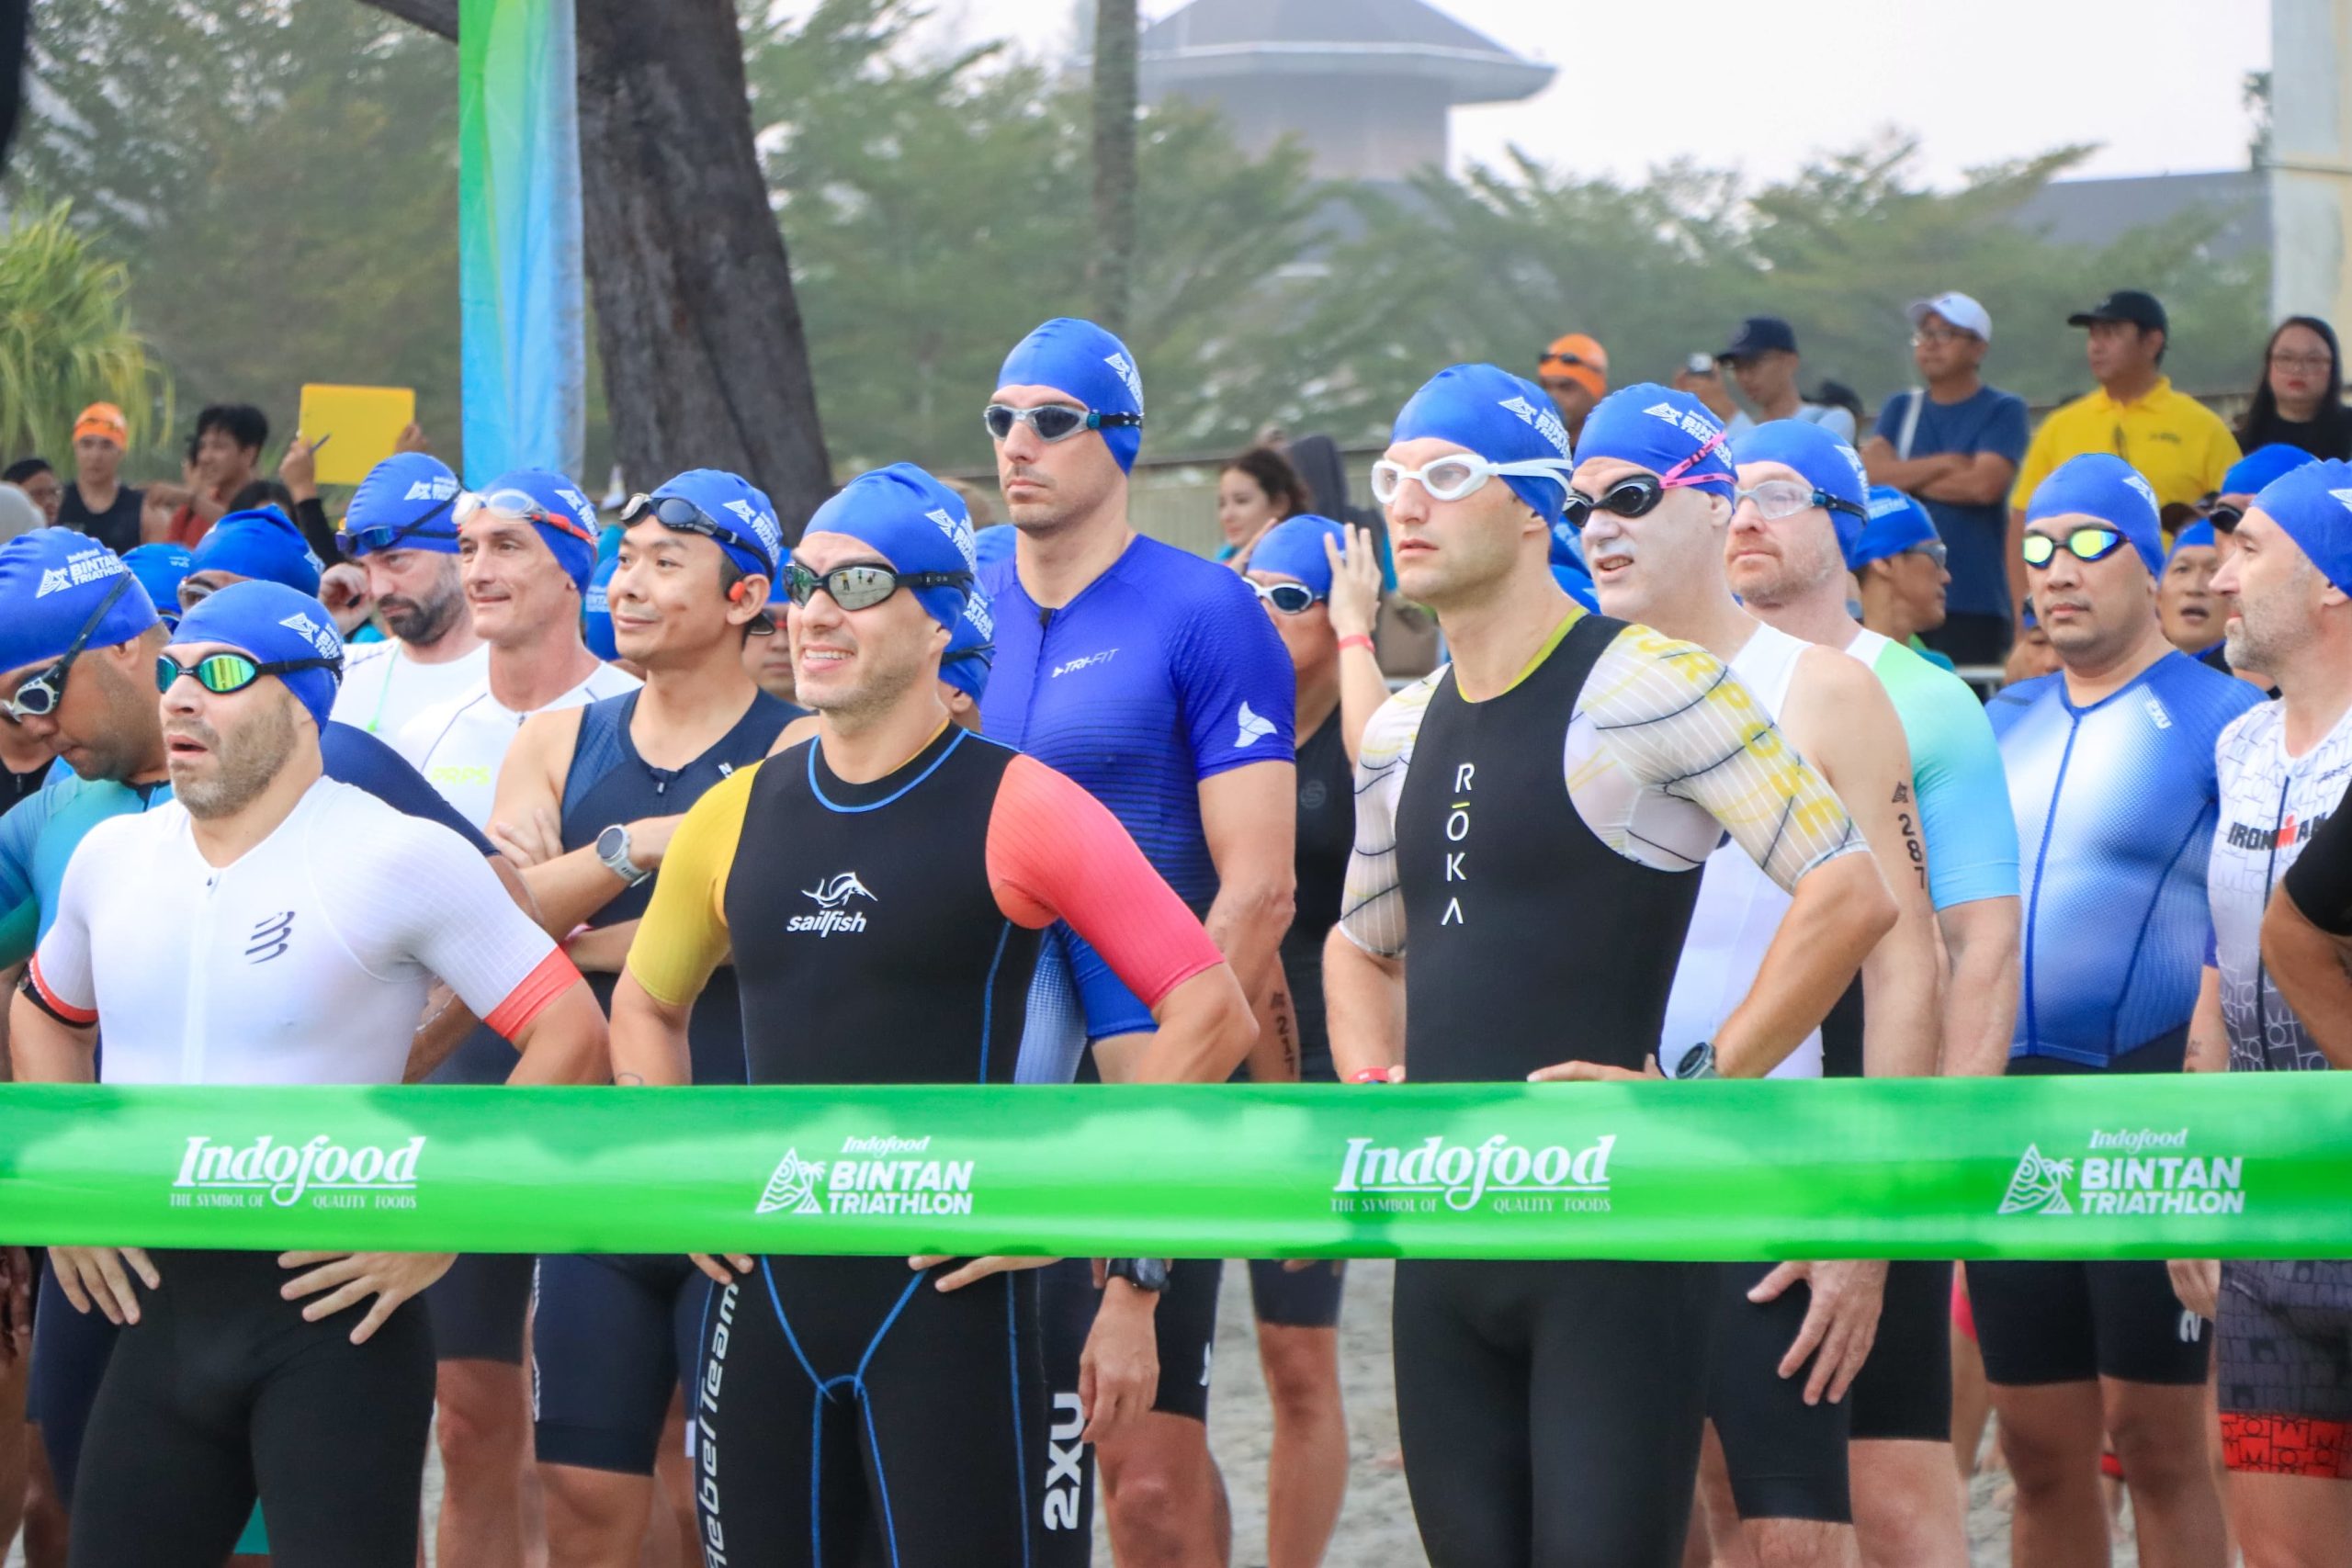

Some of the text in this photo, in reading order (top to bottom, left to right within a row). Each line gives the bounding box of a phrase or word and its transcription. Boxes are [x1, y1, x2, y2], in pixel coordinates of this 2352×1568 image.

[1064, 648, 1120, 674] TRI-FIT
[1898, 813, 1925, 889] 287
[786, 910, 867, 938] sailfish
[841, 1135, 931, 1158] Indofood
[2088, 1128, 2188, 1155] Indofood
[173, 1134, 426, 1206] Indofood
[829, 1161, 974, 1190] BINTAN
[1333, 1134, 1617, 1212] Indofood
[2081, 1156, 2243, 1190] BINTAN
[170, 1194, 417, 1209] THE SYMBOL OF QUALITY FOODS
[828, 1192, 973, 1214] TRIATHLON
[1330, 1198, 1611, 1213] THE SYMBOL OF QUALITY FOODS
[2079, 1191, 2245, 1214] TRIATHLON
[1044, 1393, 1086, 1530] 2XU
